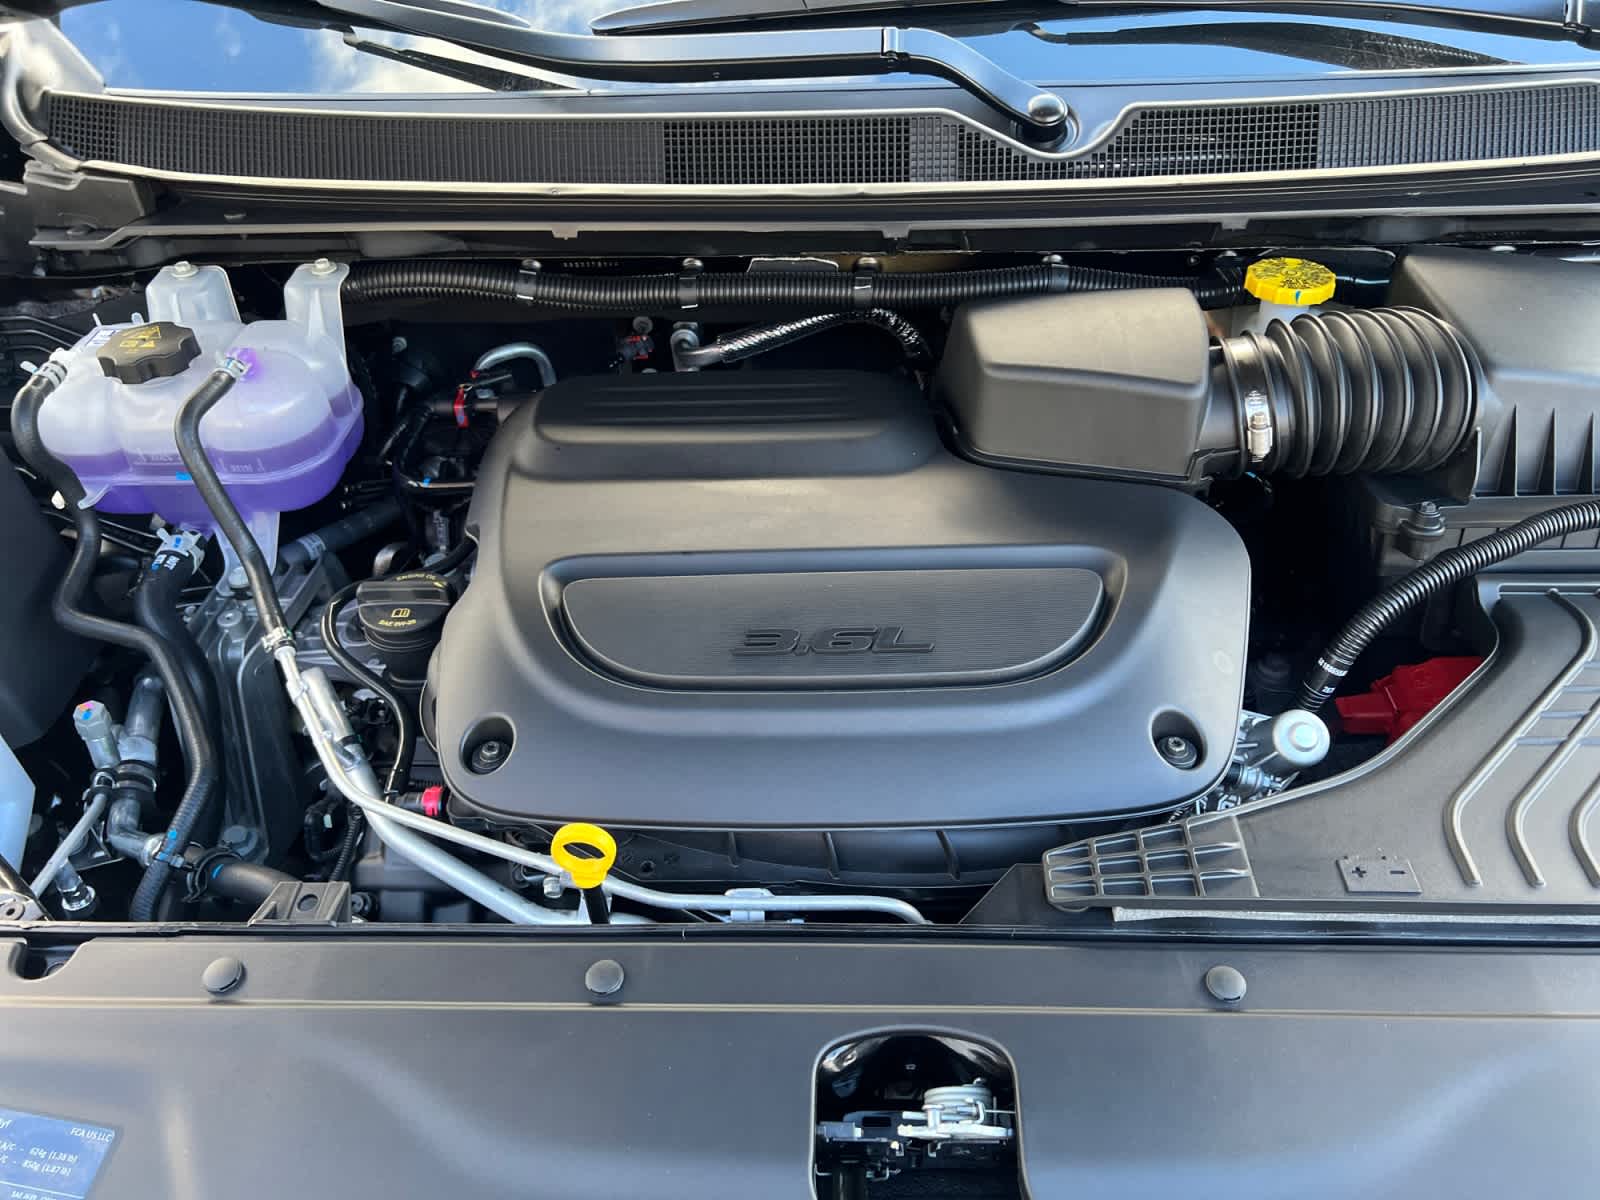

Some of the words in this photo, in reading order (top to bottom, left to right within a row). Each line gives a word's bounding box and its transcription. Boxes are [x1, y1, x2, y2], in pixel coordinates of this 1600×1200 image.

[731, 624, 935, 656] 3.6L
[70, 1127, 85, 1137] FCA
[86, 1131, 97, 1140] US
[97, 1134, 113, 1143] LLC
